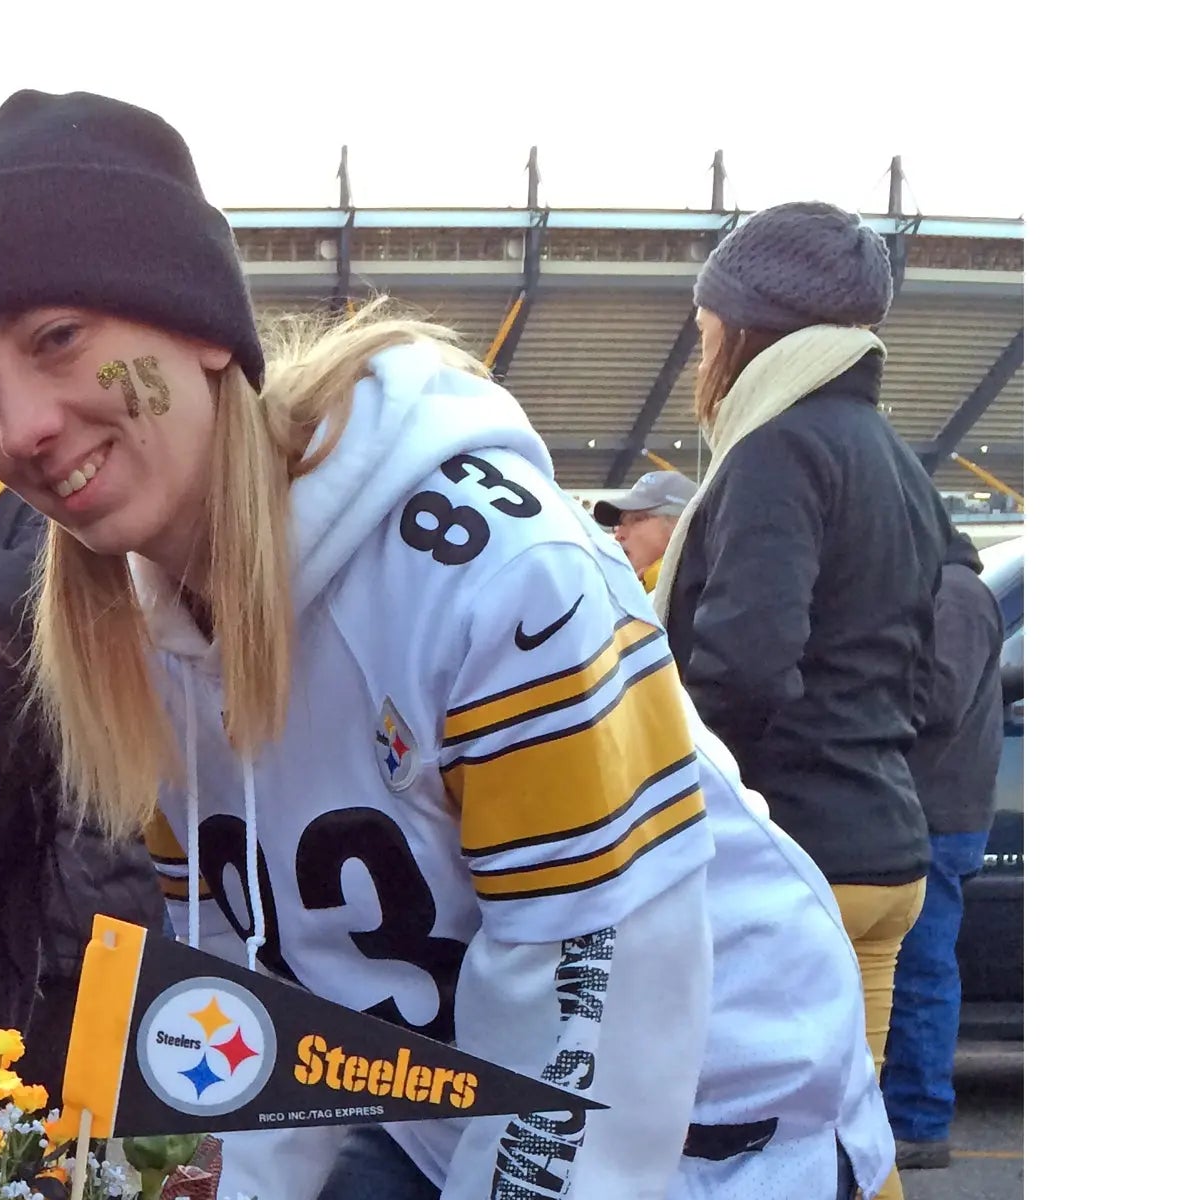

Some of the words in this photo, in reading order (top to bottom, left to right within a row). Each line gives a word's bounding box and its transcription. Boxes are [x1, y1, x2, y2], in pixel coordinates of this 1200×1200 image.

[96, 355, 171, 420] 75
[400, 454, 542, 566] 83
[155, 1030, 202, 1051] Steelers
[294, 1034, 479, 1110] Steelers
[258, 1112, 285, 1123] RICO
[334, 1105, 385, 1119] EXPRESS
